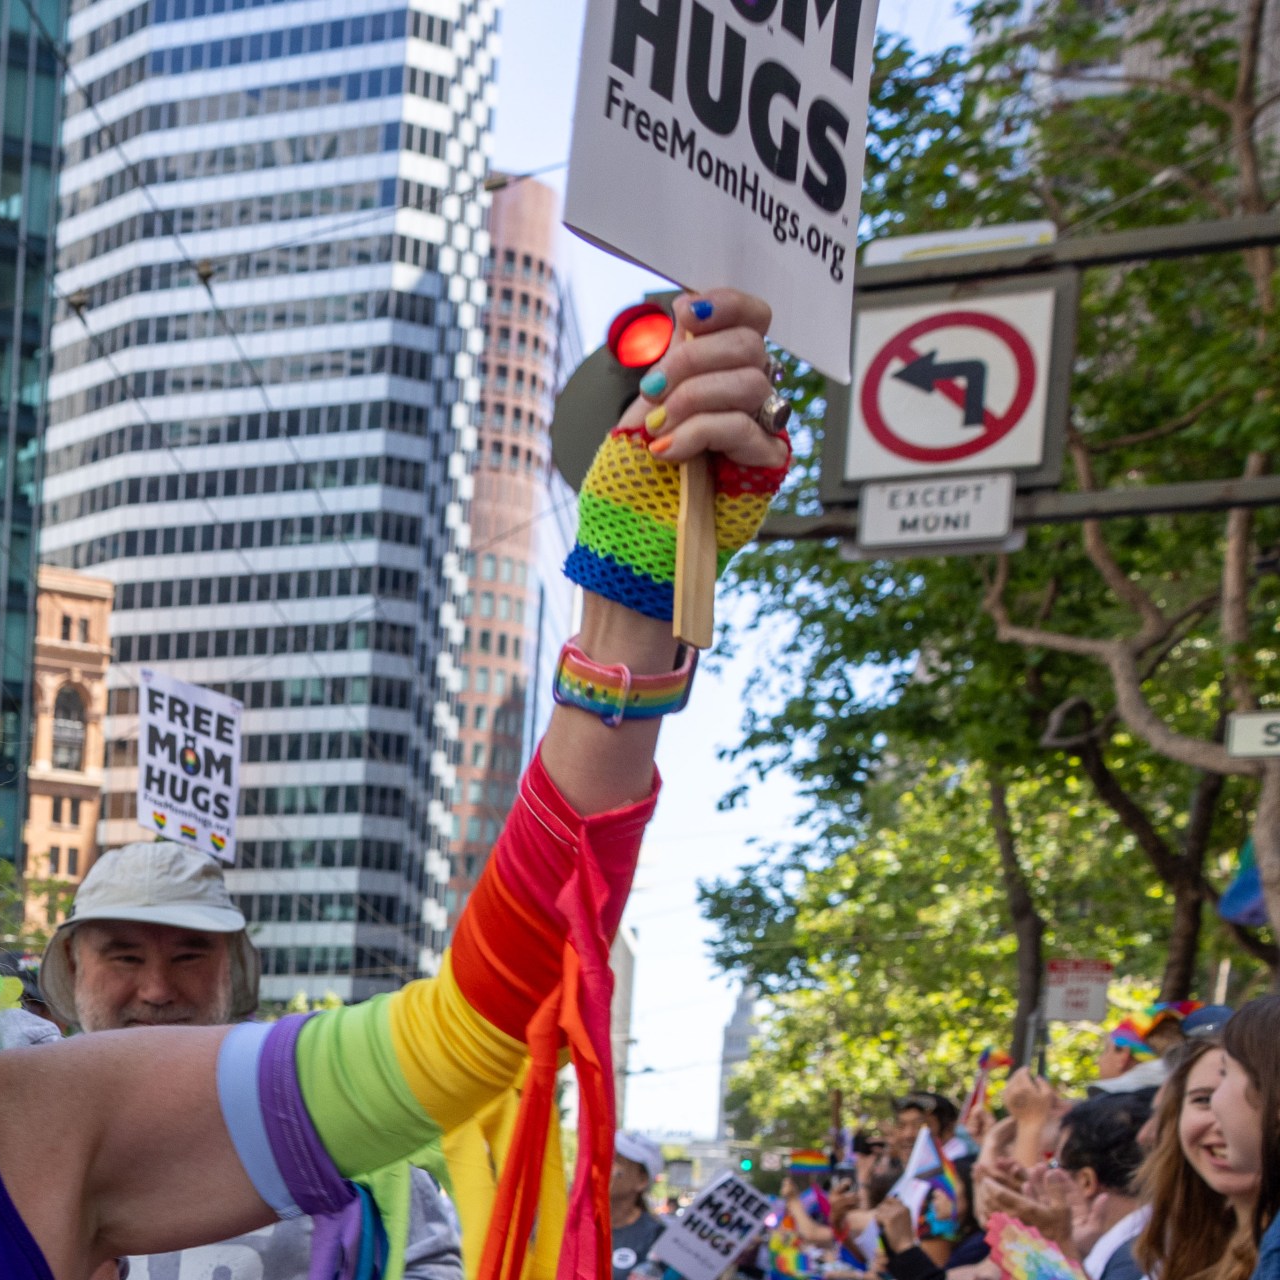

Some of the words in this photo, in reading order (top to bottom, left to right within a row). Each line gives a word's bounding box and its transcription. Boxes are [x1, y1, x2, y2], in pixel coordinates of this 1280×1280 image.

[610, 0, 850, 215] HUGS
[604, 76, 846, 284] FreeMomHugs.org
[888, 483, 984, 510] EXCEPT
[899, 511, 971, 533] MUNI
[147, 688, 235, 745] FREE
[147, 724, 233, 787] MOM
[145, 765, 230, 820] HUGS
[698, 1194, 754, 1237] MOM
[715, 1177, 771, 1219] FREE
[682, 1214, 736, 1257] HUGS
